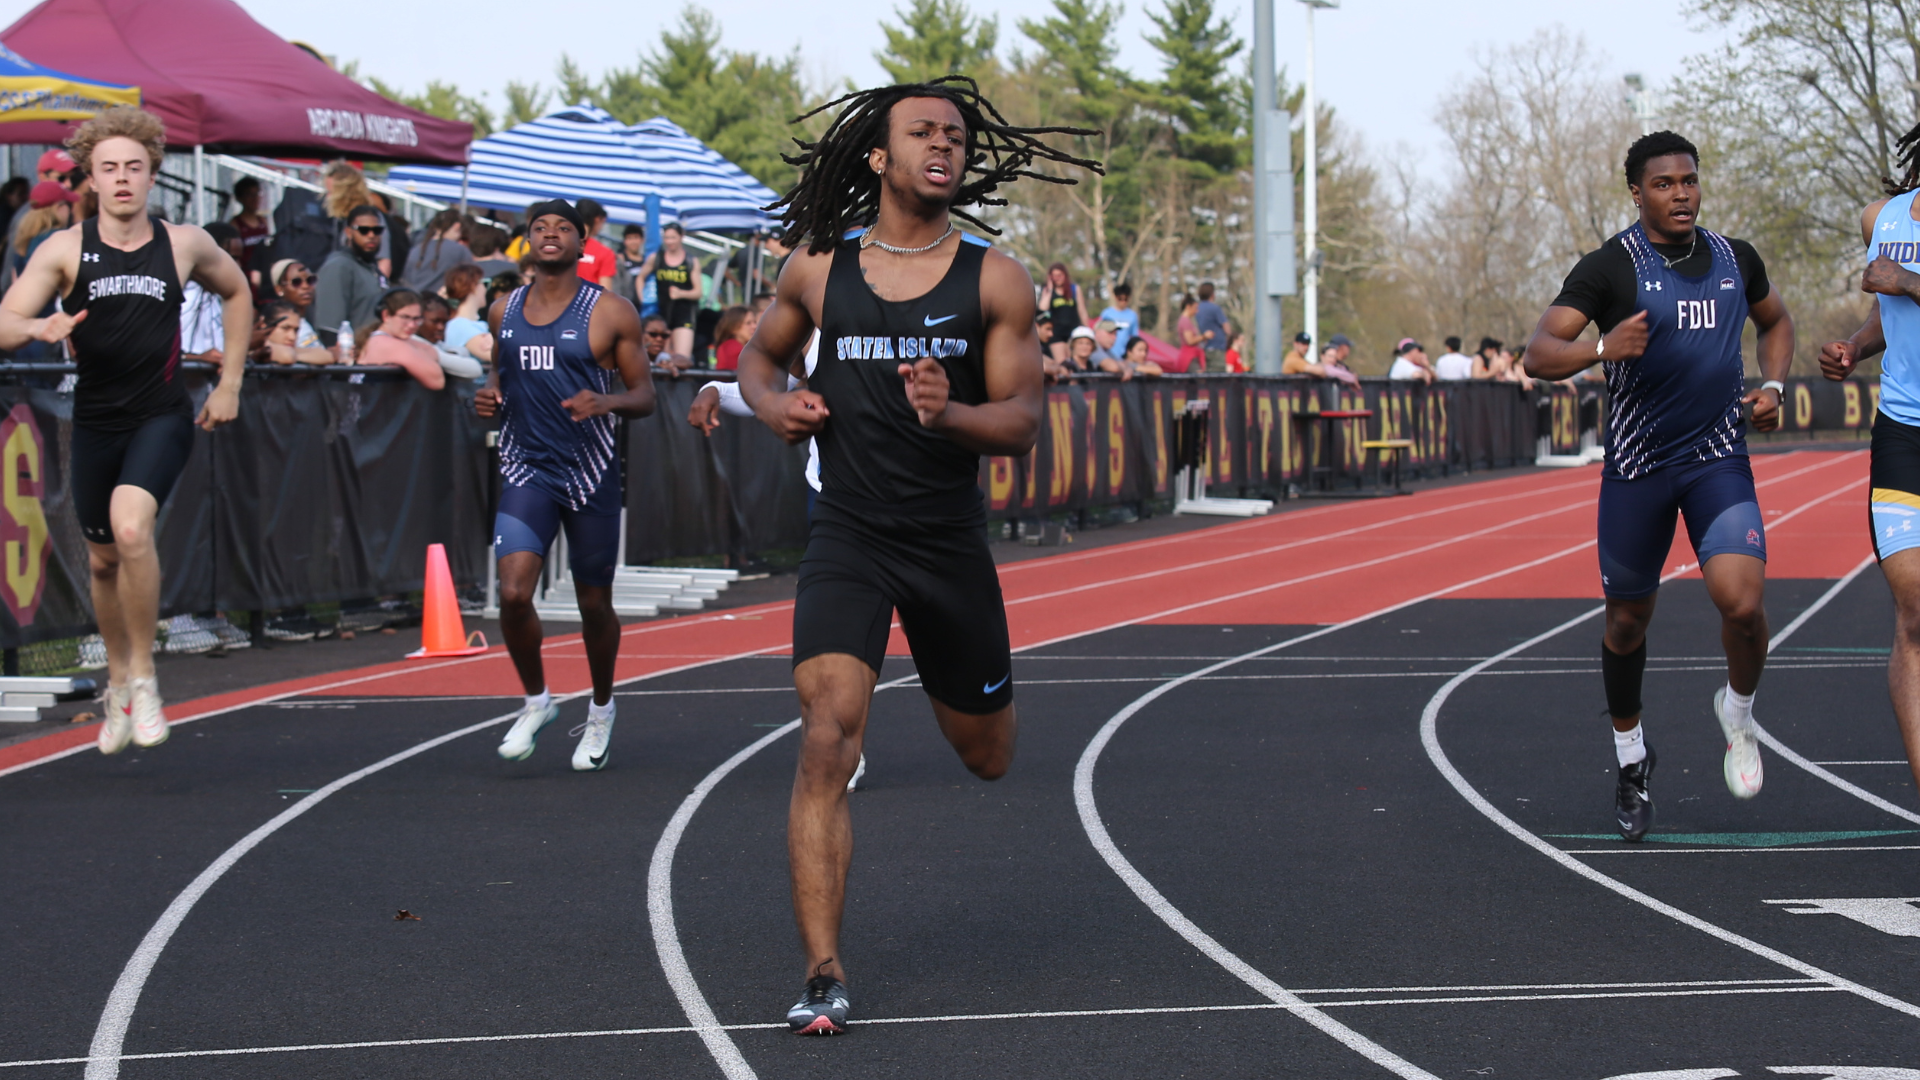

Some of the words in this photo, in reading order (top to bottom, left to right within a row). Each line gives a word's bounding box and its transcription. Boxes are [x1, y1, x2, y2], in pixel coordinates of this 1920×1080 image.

[306, 108, 365, 140] ARCADIA
[364, 113, 419, 147] KNIGHTS
[88, 274, 167, 301] SWARTHMORE
[1677, 299, 1716, 330] FDU
[519, 345, 555, 371] FDU
[898, 336, 968, 359] ISLAND
